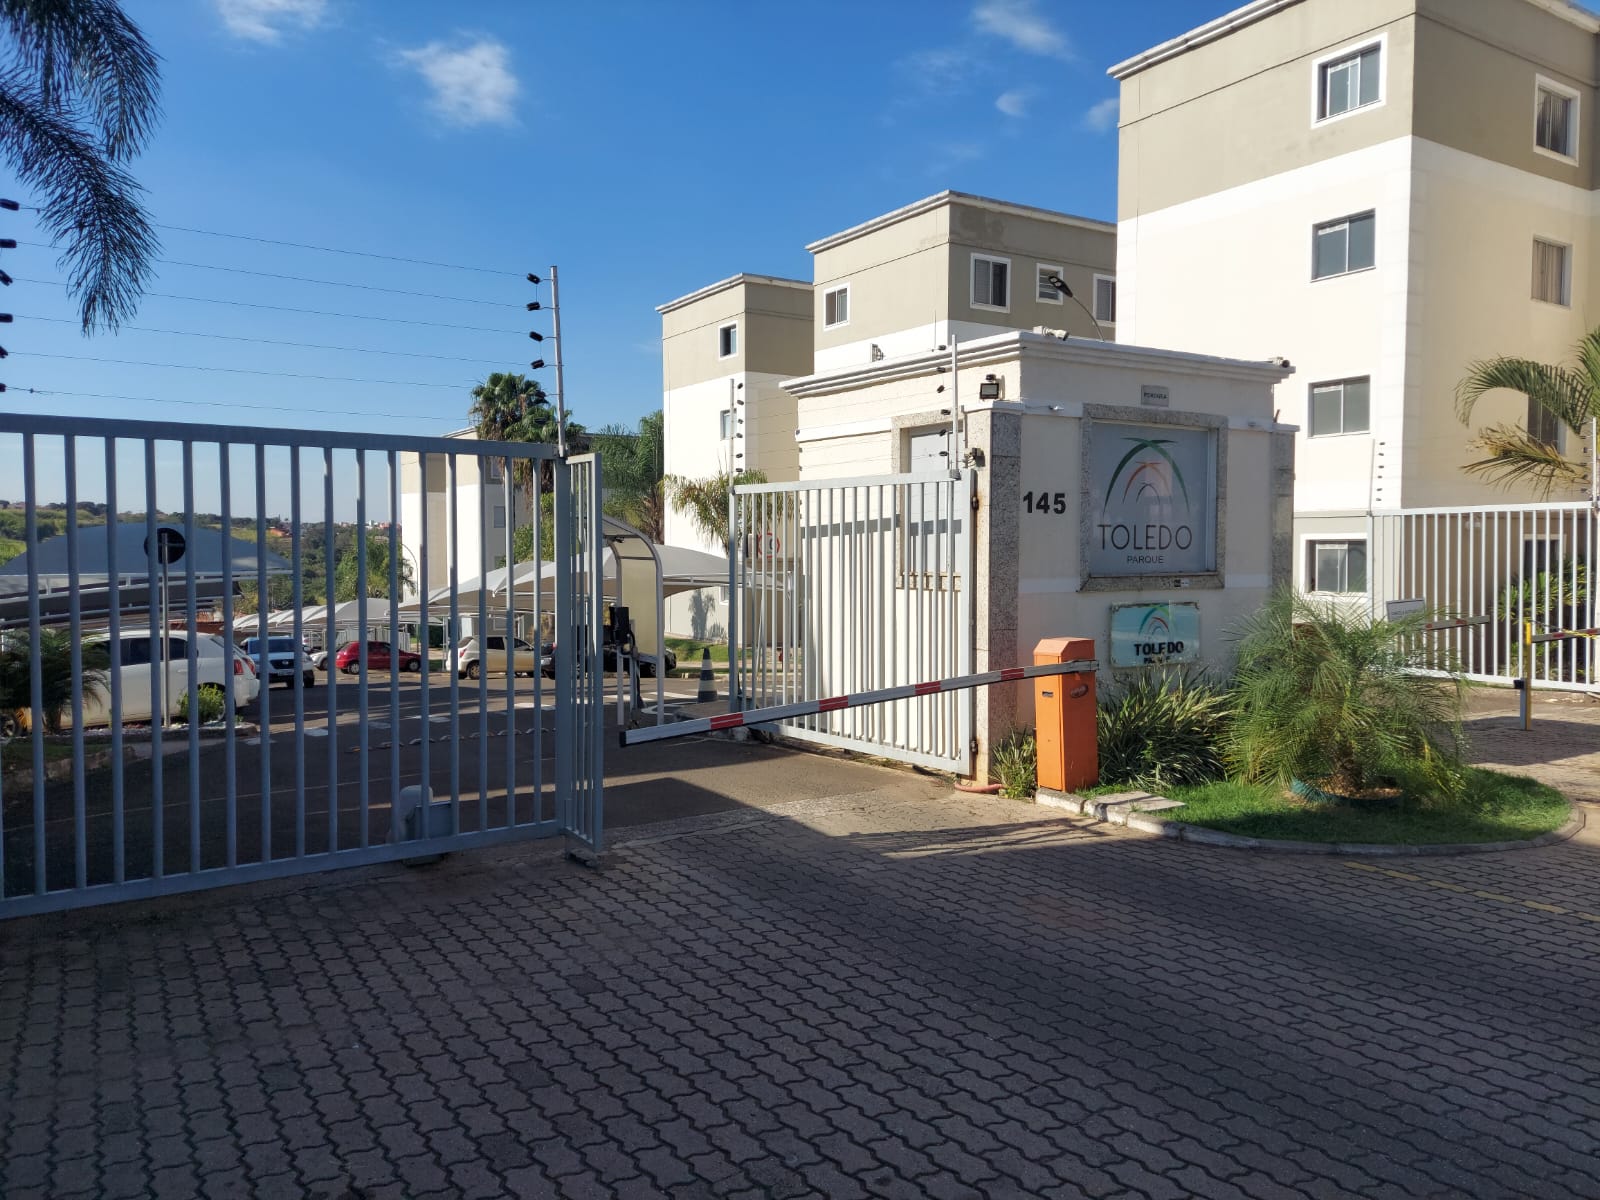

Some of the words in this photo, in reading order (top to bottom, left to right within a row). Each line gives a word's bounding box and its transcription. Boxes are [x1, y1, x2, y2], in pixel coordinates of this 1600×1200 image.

[1023, 491, 1067, 514] 145
[1097, 524, 1193, 551] TOLEDO
[1127, 555, 1165, 564] PARQUE
[1133, 641, 1185, 657] TOLEDO
